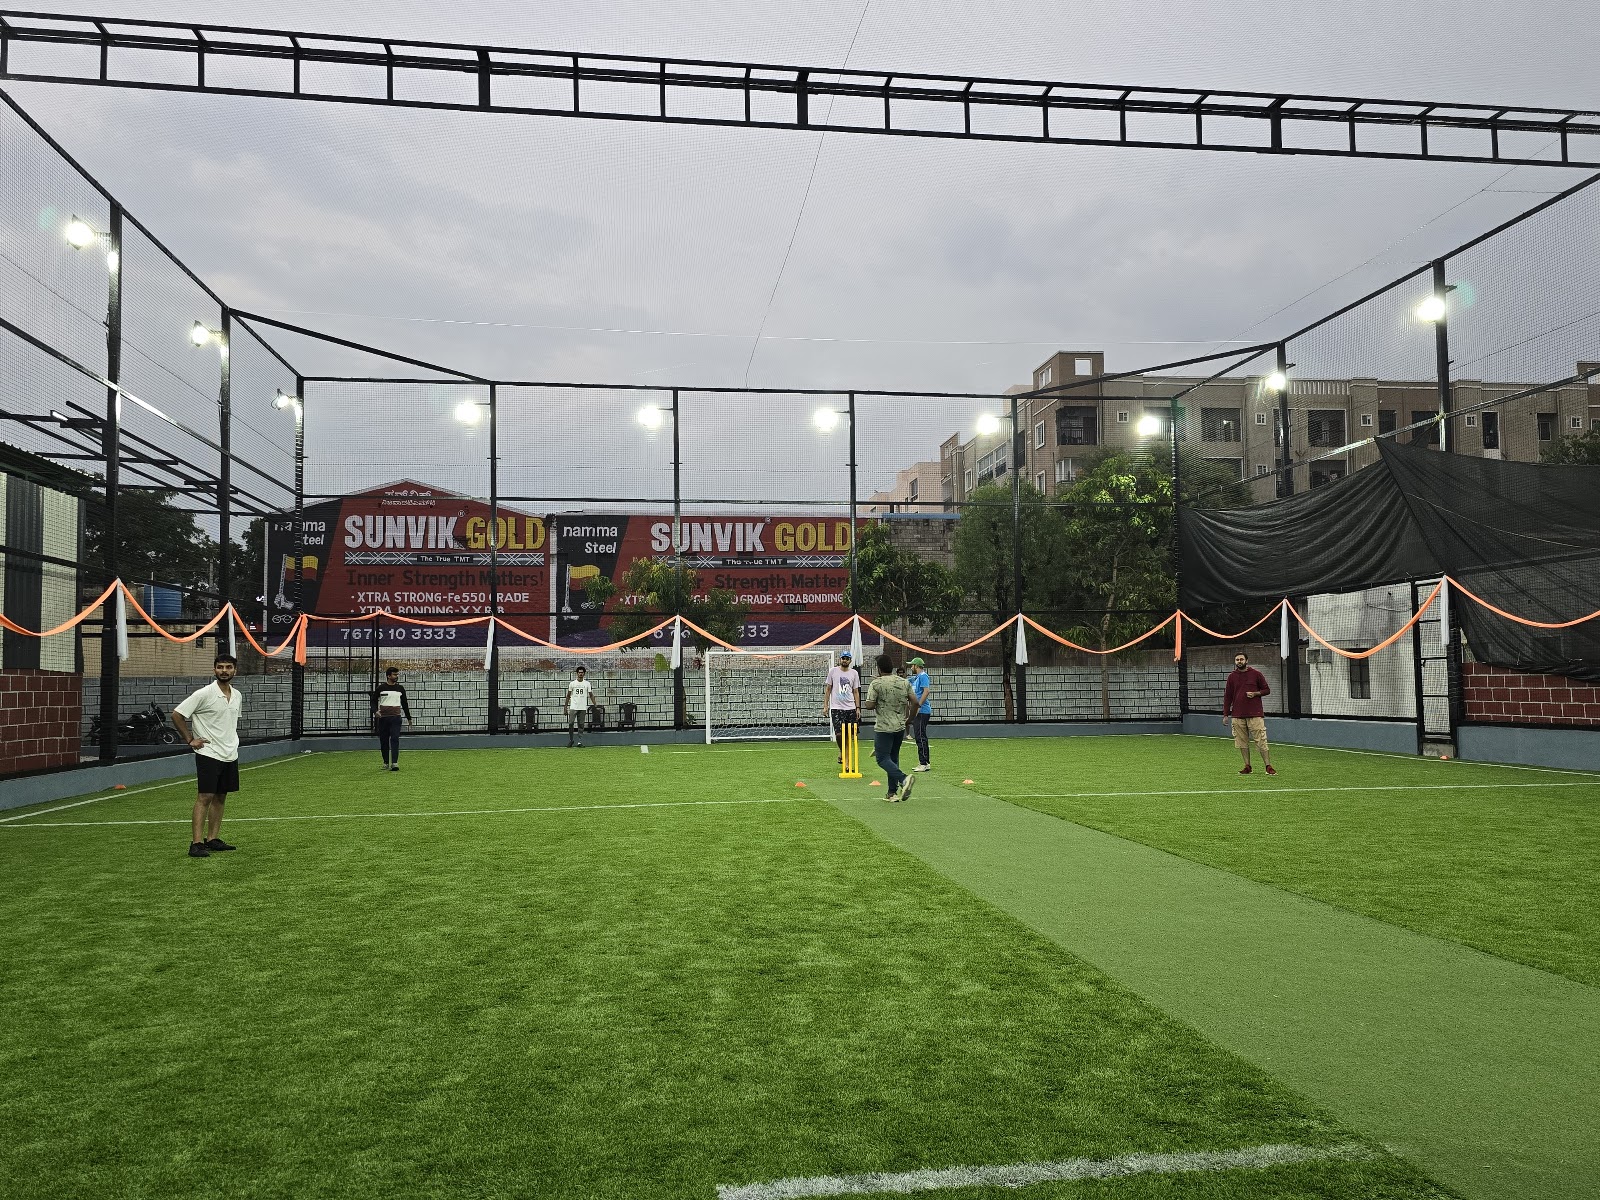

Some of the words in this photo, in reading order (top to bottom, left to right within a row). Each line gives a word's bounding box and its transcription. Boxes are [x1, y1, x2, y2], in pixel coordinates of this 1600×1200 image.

[344, 515, 461, 549] SUNVIK
[465, 516, 546, 550] GOLD
[563, 526, 618, 537] namma
[651, 522, 764, 552] SUNVIK
[774, 522, 852, 552] GOLD
[301, 534, 325, 545] teel
[585, 541, 617, 553] Steel
[454, 555, 470, 563] TMT
[346, 569, 396, 586] Inner
[402, 569, 475, 590] Strength
[714, 573, 787, 593] Strength
[357, 591, 391, 603] XTRA
[740, 594, 773, 605] GRADE
[388, 628, 406, 640] 10
[411, 628, 457, 640] 3333
